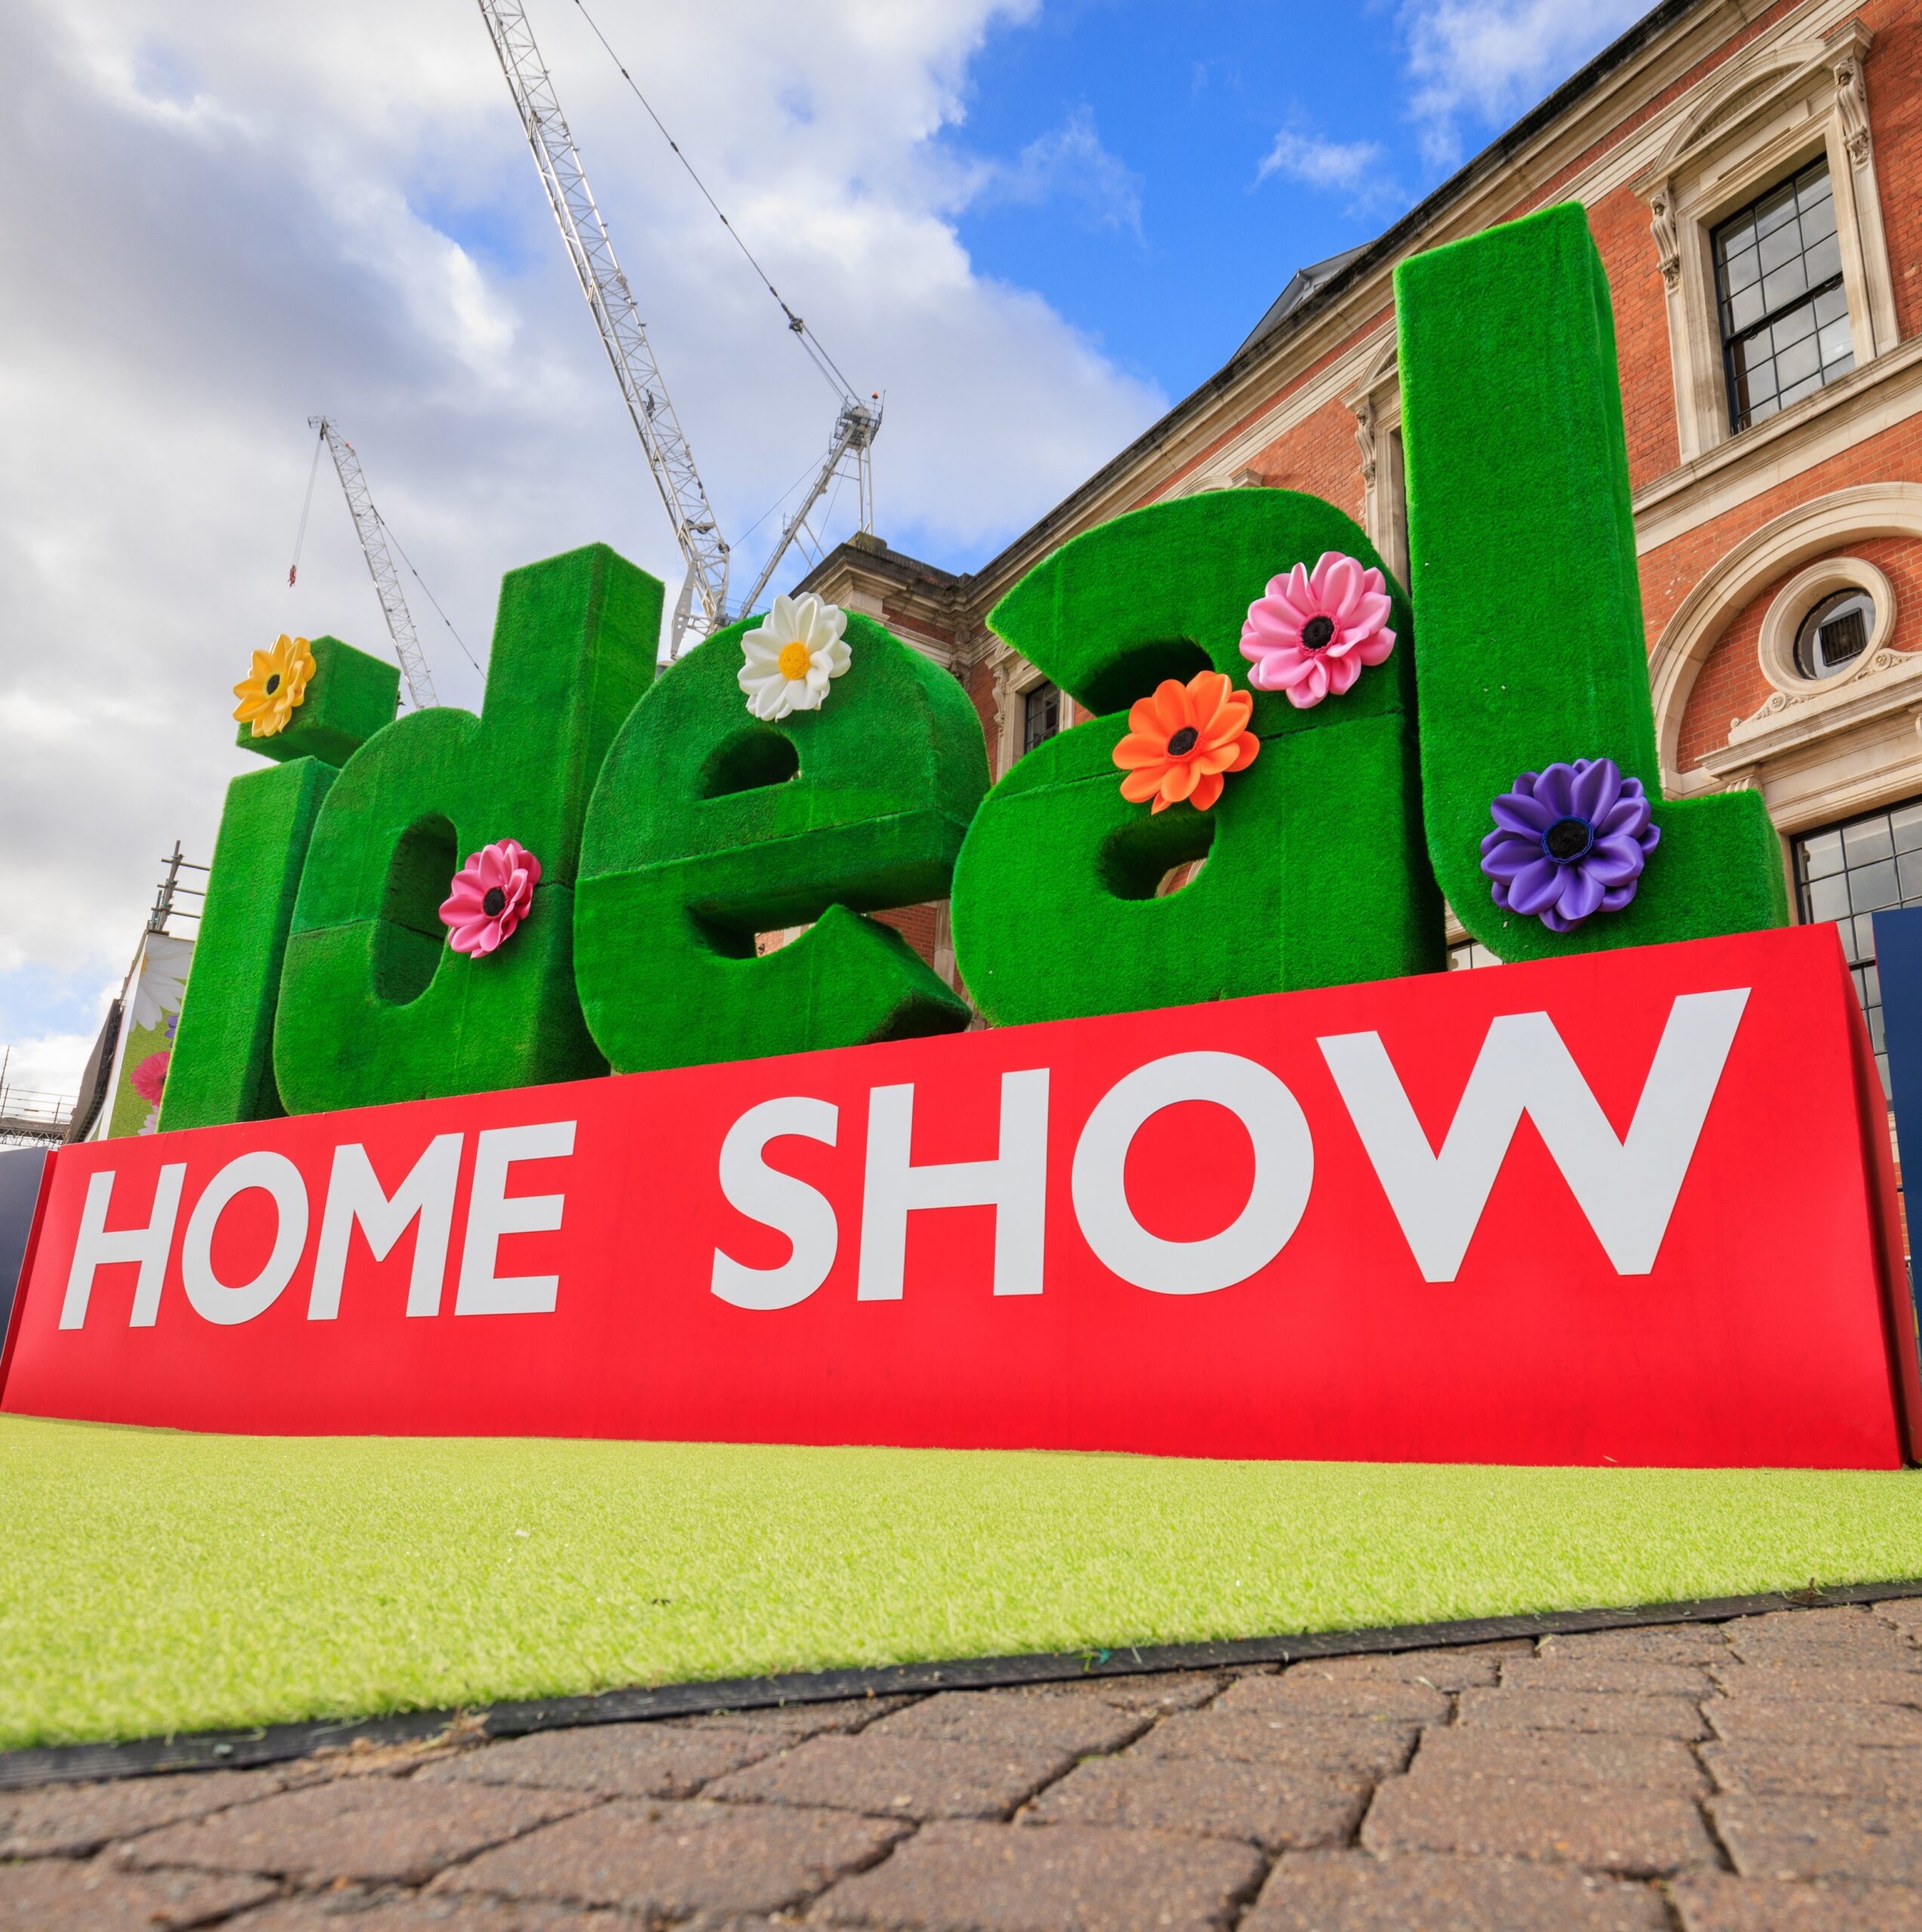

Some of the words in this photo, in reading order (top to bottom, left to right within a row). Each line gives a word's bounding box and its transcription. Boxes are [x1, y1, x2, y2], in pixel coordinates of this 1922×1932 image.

[158, 201, 1788, 1131] ideal
[58, 1121, 577, 1331] HOME
[710, 986, 1751, 1310] SHOW
